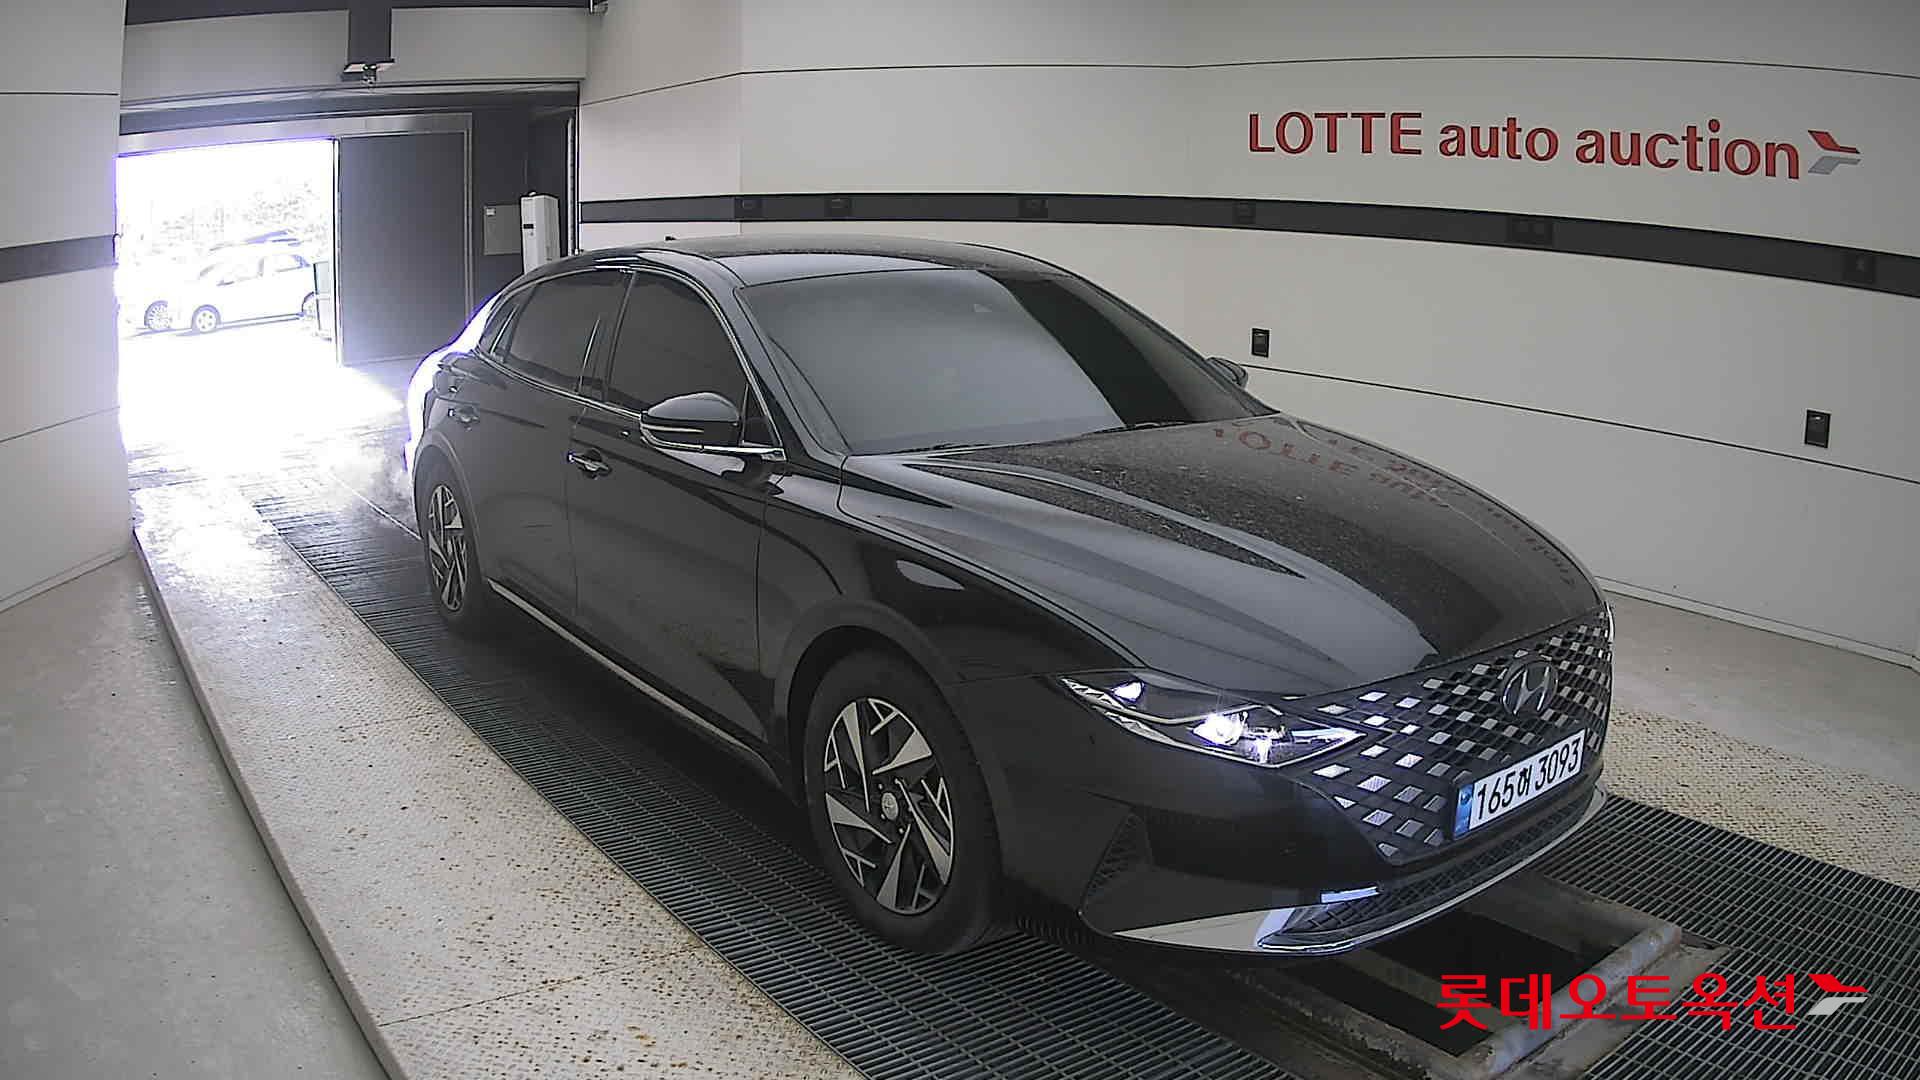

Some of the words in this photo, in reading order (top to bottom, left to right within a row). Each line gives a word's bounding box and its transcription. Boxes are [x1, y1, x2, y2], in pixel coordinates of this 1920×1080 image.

[1248, 111, 1423, 155] LOTTE
[1438, 117, 1560, 162] auto
[1575, 119, 1800, 180] auction
